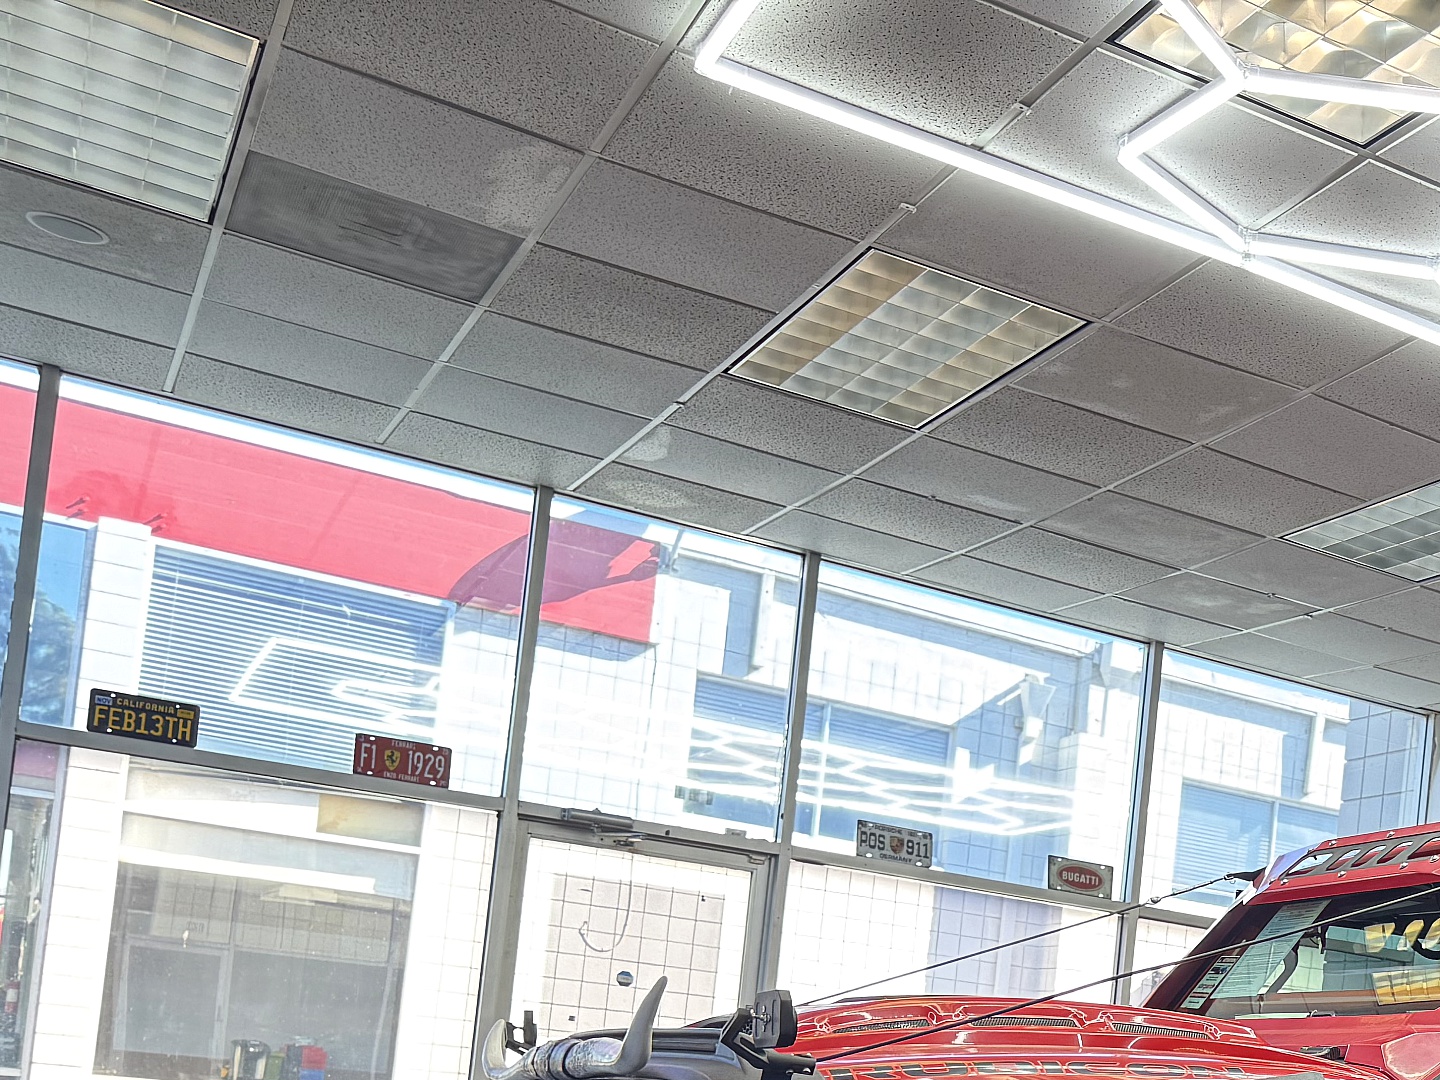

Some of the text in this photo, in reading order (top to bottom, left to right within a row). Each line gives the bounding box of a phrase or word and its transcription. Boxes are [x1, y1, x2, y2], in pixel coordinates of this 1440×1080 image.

[116, 698, 175, 714] CALIFORNIA
[93, 705, 192, 742] FEB13TH
[360, 743, 445, 779] F1 1929
[879, 853, 913, 863] GERMANY
[906, 839, 930, 859] 911
[1062, 871, 1099, 886] BUGATTI
